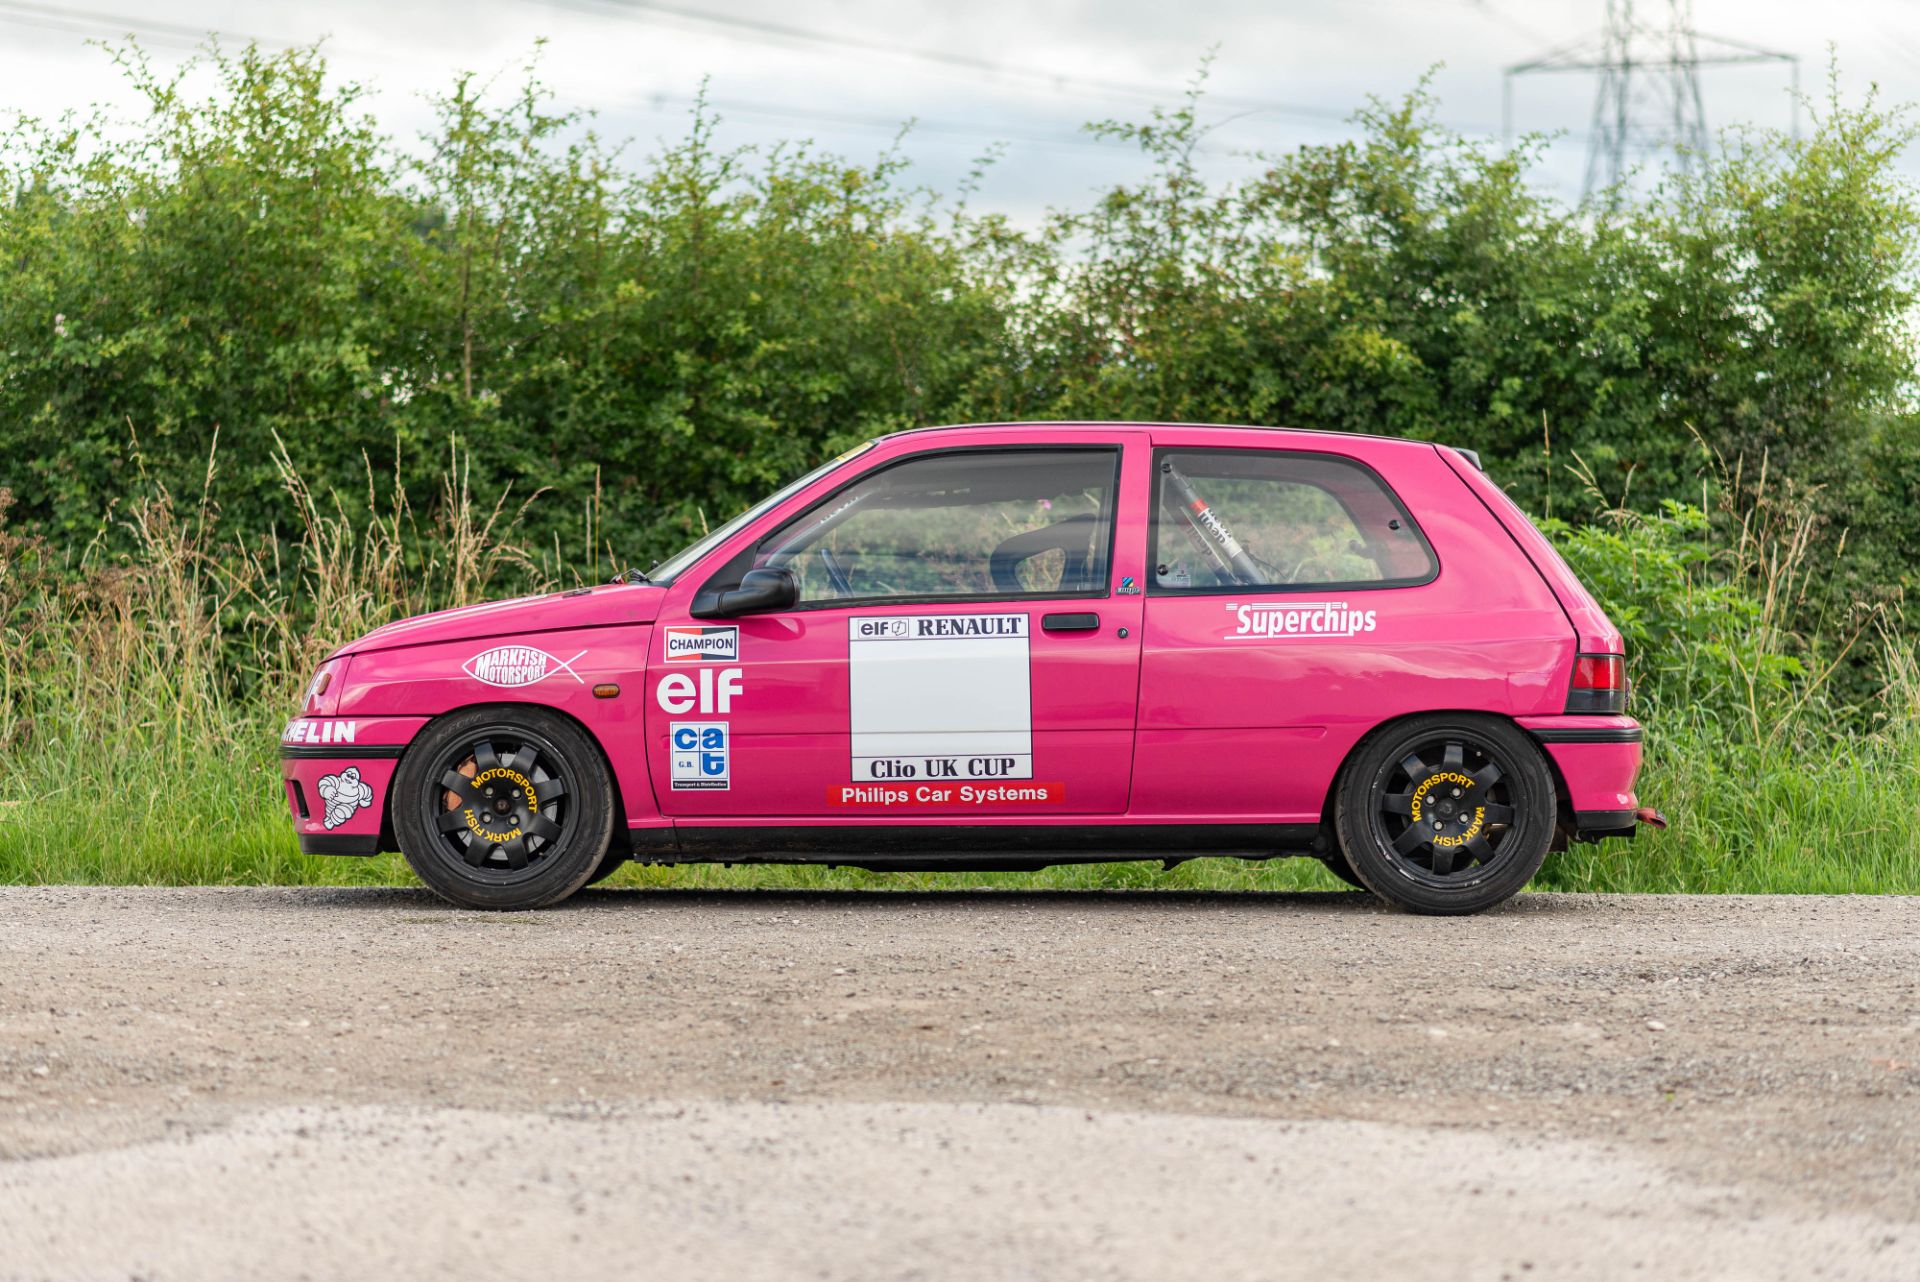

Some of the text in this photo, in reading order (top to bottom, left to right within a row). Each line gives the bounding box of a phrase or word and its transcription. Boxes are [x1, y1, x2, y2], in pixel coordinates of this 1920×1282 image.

[860, 617, 1022, 636] elf RENAULT
[1236, 602, 1377, 638] Superchips
[669, 638, 734, 650] CHAMPION
[475, 649, 547, 674] MARKFISH
[656, 668, 743, 715] elf
[870, 757, 1016, 779] Clio UK CUP
[471, 768, 538, 814] MOTORSPORT
[842, 786, 1048, 805] Philips Car Systems
[1411, 772, 1476, 822] MOTORSPORT
[464, 809, 522, 843] MARK FISH
[1433, 806, 1485, 847] MARK FISH
